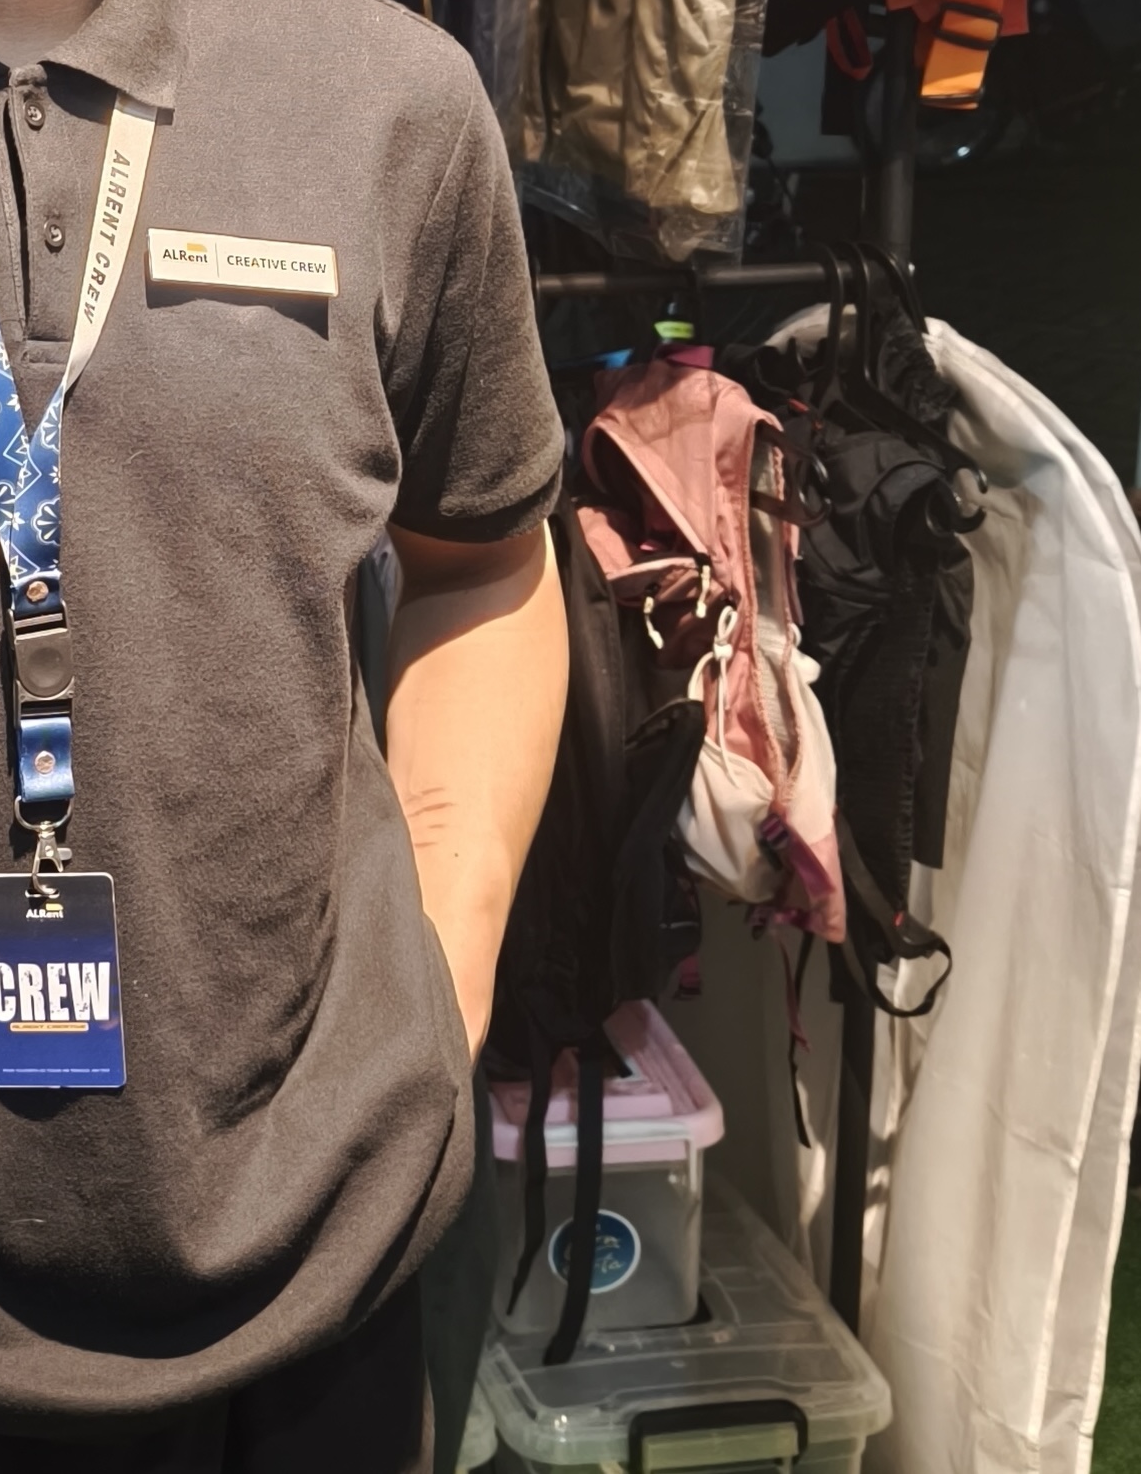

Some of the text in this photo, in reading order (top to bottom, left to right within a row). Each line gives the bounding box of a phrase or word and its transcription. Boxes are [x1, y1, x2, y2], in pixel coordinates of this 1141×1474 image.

[83, 149, 131, 324] ALRENT CREW
[162, 248, 208, 263] ALRent
[226, 254, 327, 274] CREATIVE CREW
